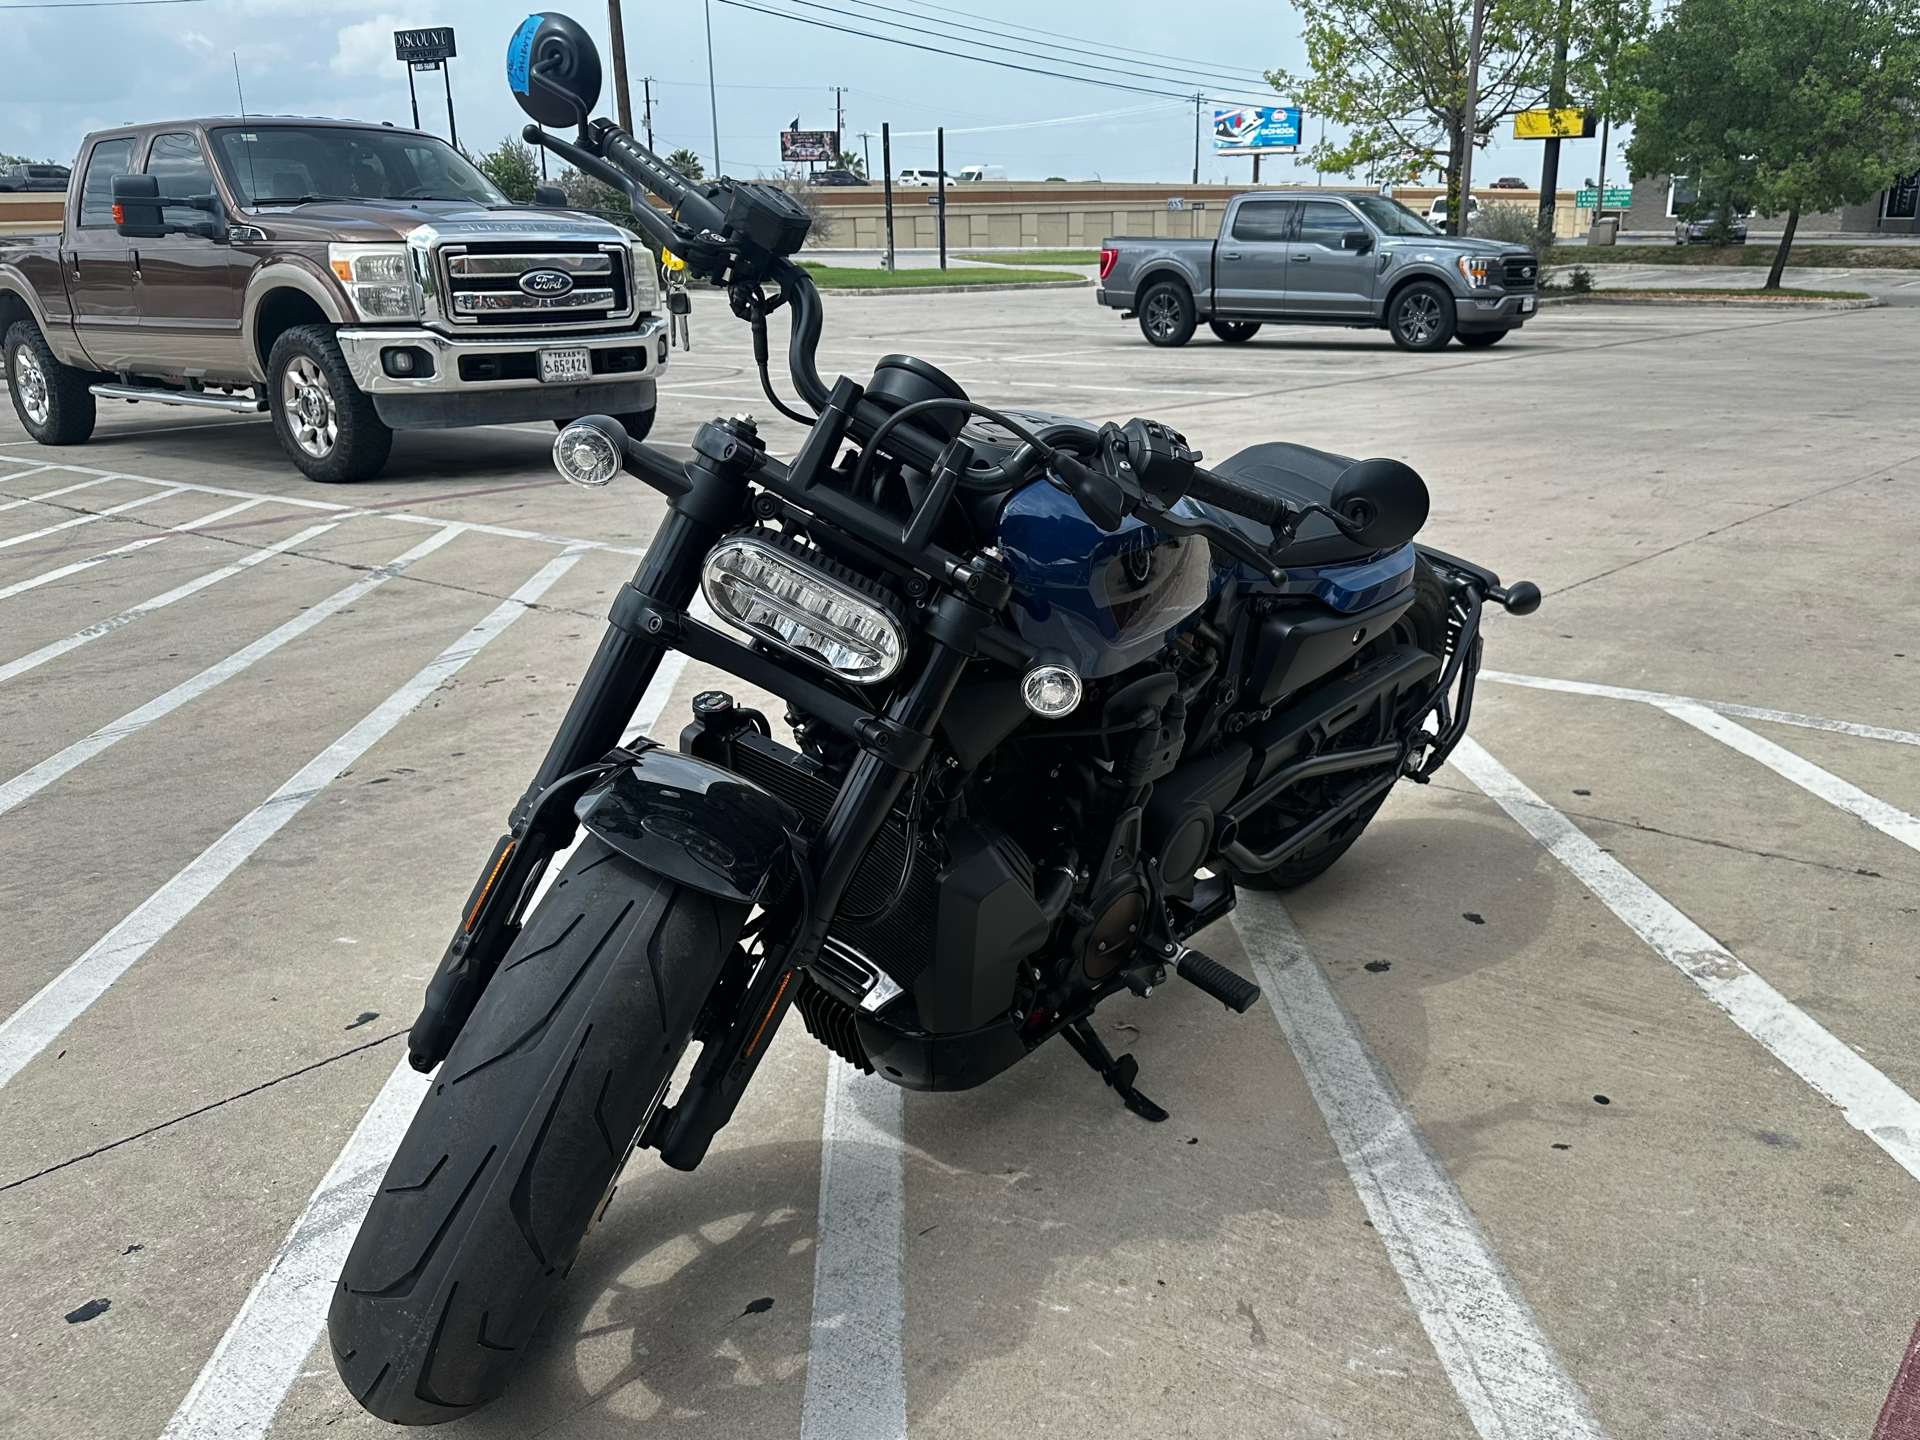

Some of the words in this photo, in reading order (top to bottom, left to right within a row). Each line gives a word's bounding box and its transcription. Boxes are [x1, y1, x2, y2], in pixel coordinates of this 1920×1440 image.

[395, 31, 446, 48] DISCOUNT
[534, 274, 563, 290] Ford
[553, 351, 577, 359] TEXAS
